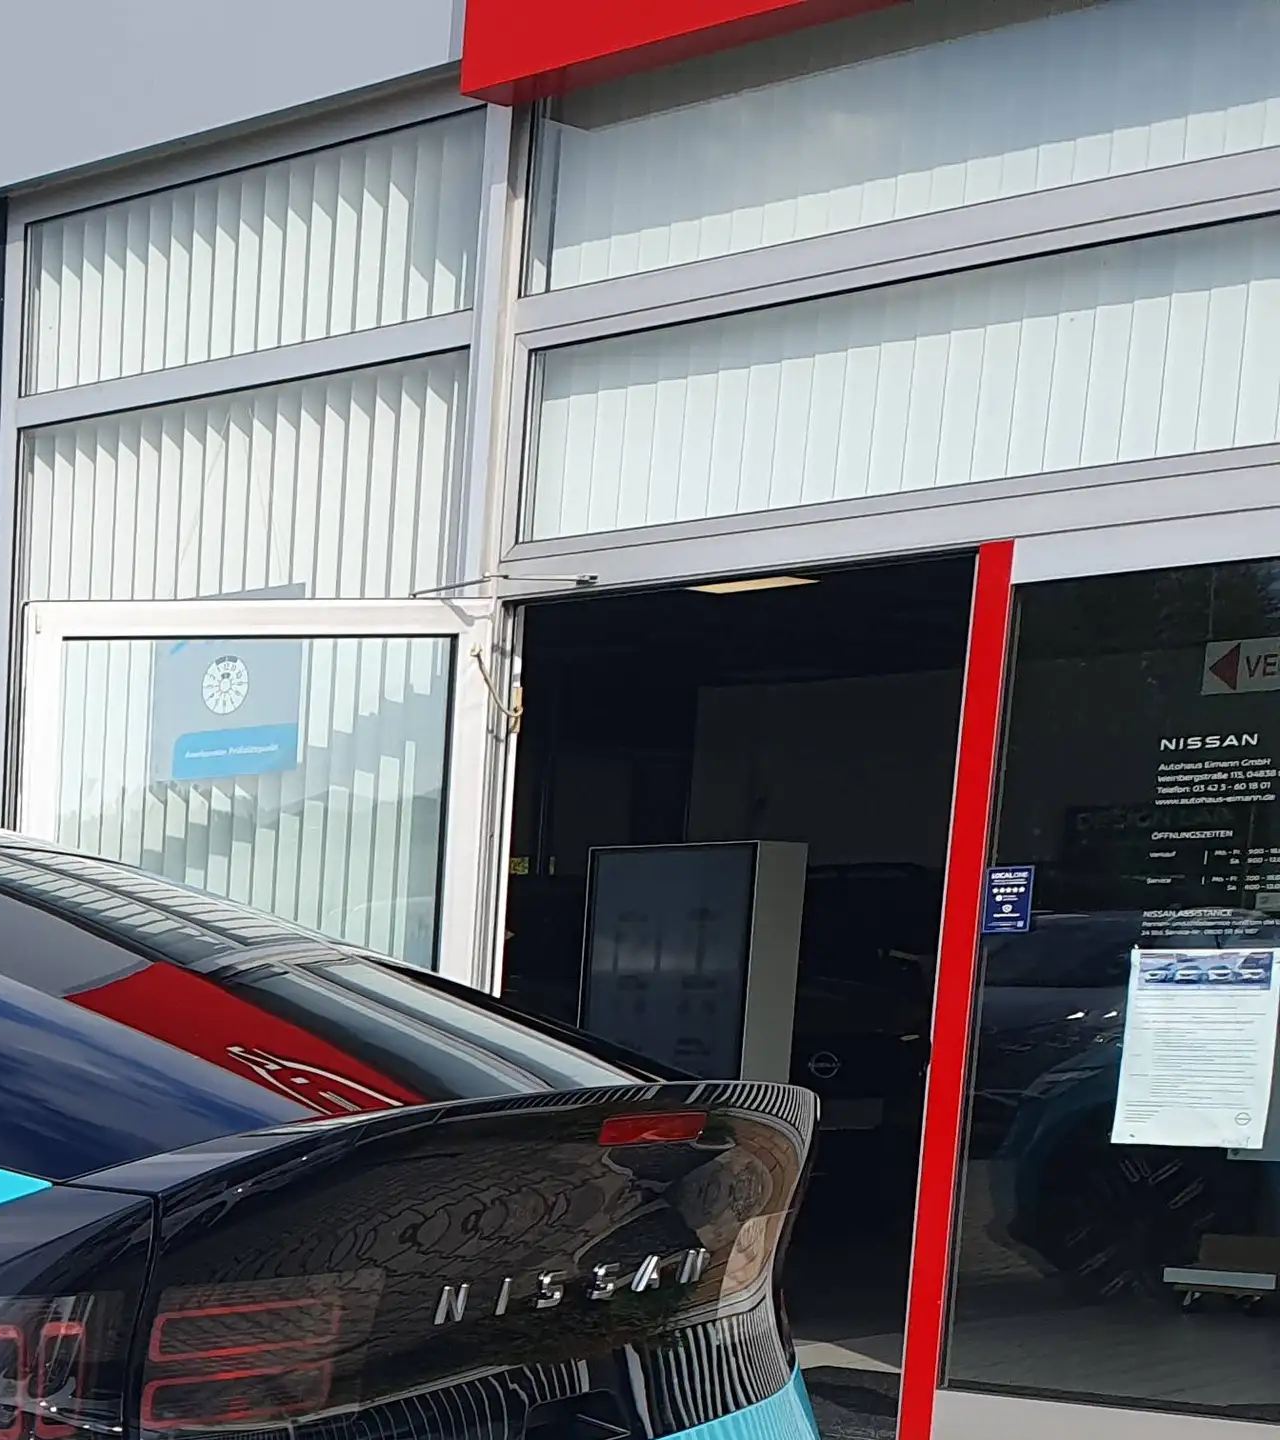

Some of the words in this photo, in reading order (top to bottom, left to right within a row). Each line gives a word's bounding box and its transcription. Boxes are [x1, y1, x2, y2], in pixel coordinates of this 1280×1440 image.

[1160, 733, 1258, 751] NISSAN
[1158, 762, 1202, 771] Autohaus
[1241, 758, 1271, 767] GmbH
[433, 1247, 711, 1325] NISSAN
